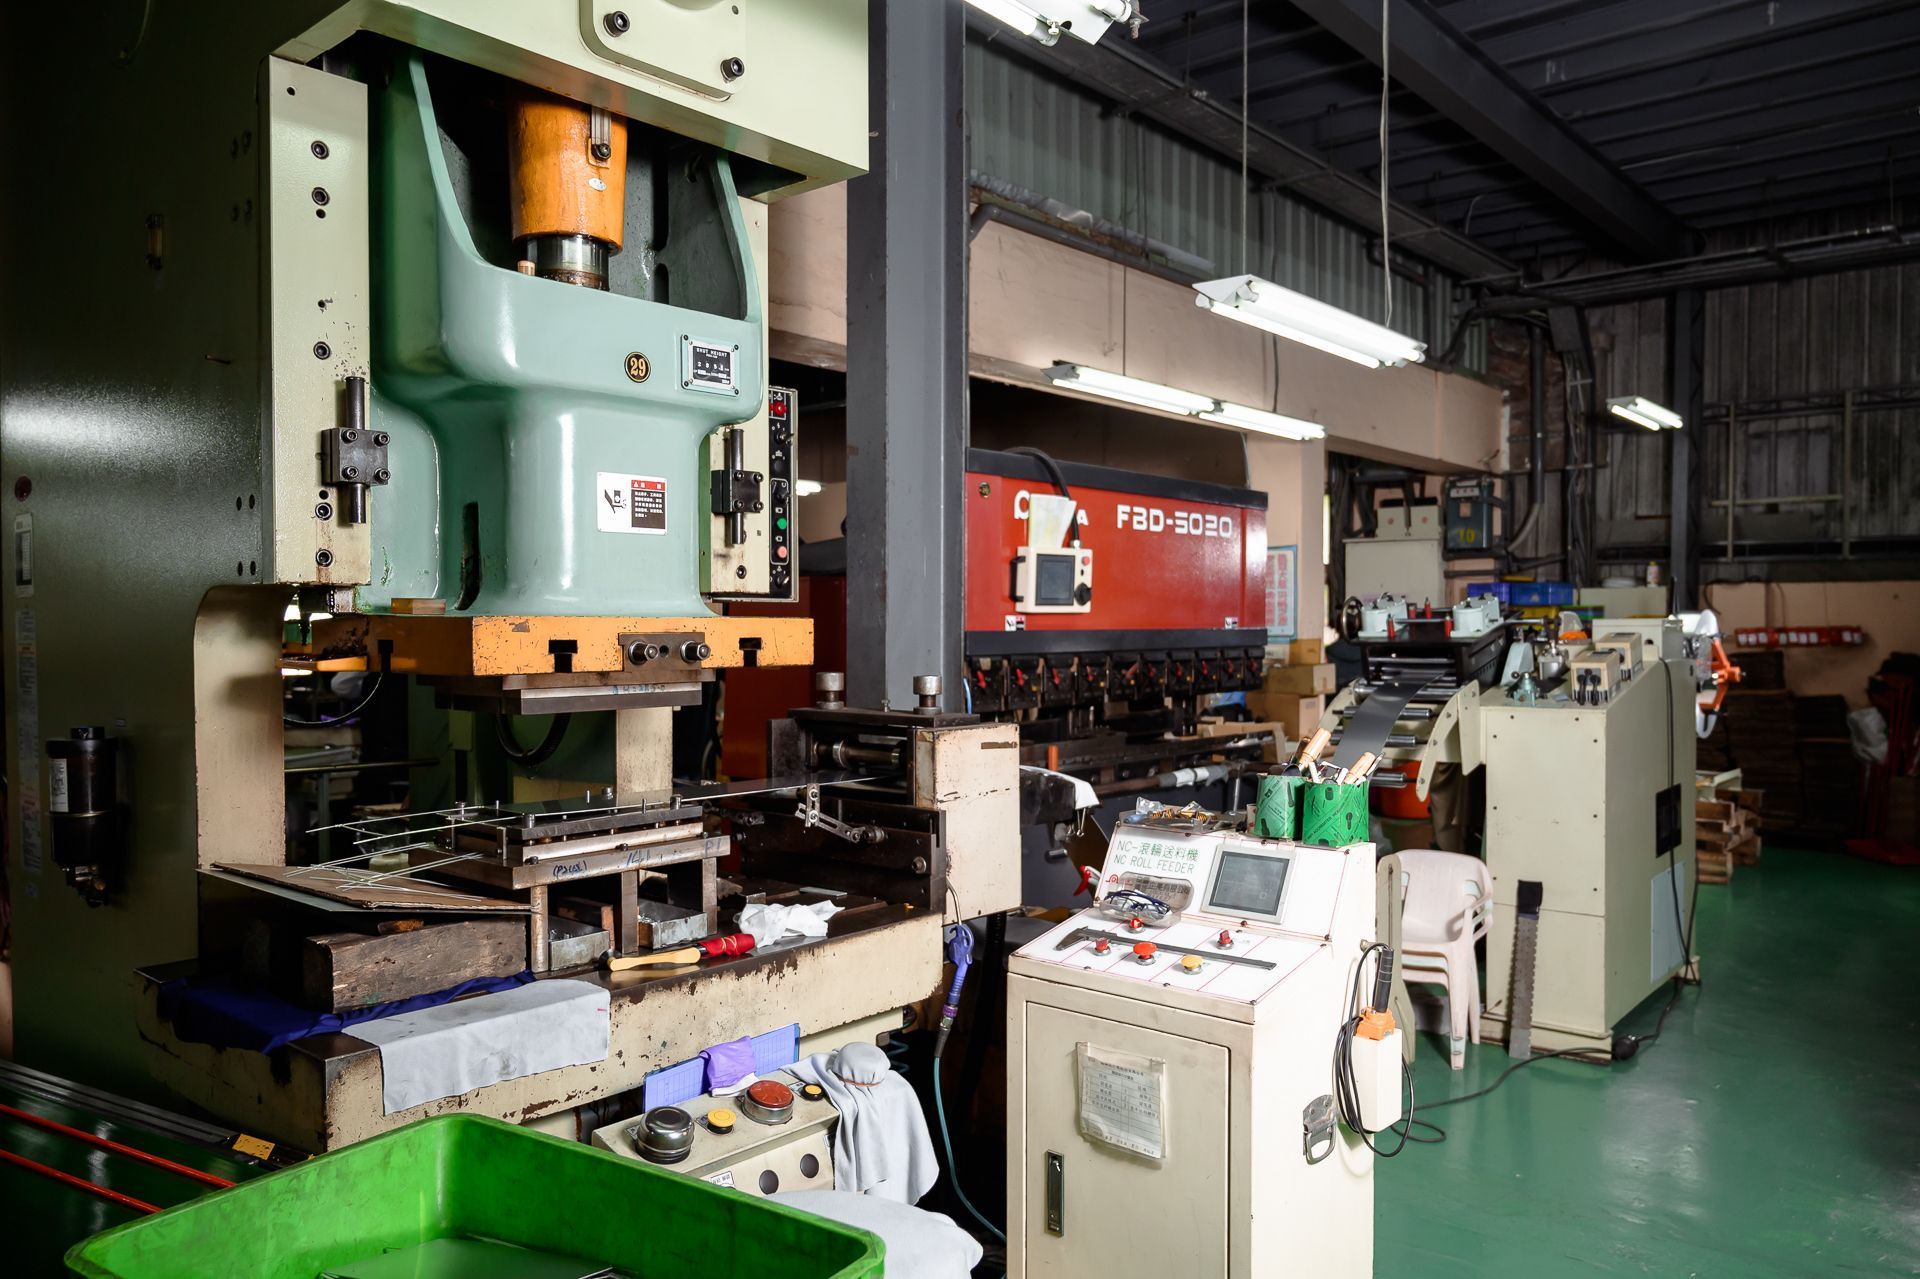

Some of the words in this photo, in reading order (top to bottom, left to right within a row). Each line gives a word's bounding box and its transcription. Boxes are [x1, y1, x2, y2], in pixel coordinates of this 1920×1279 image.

[630, 357, 646, 377] 29
[1116, 504, 1233, 537] FBD-5020
[1456, 527, 1476, 544] 10
[1114, 854, 1127, 865] NC
[1130, 856, 1153, 869] ROLL
[1156, 860, 1195, 874] FEEDER
